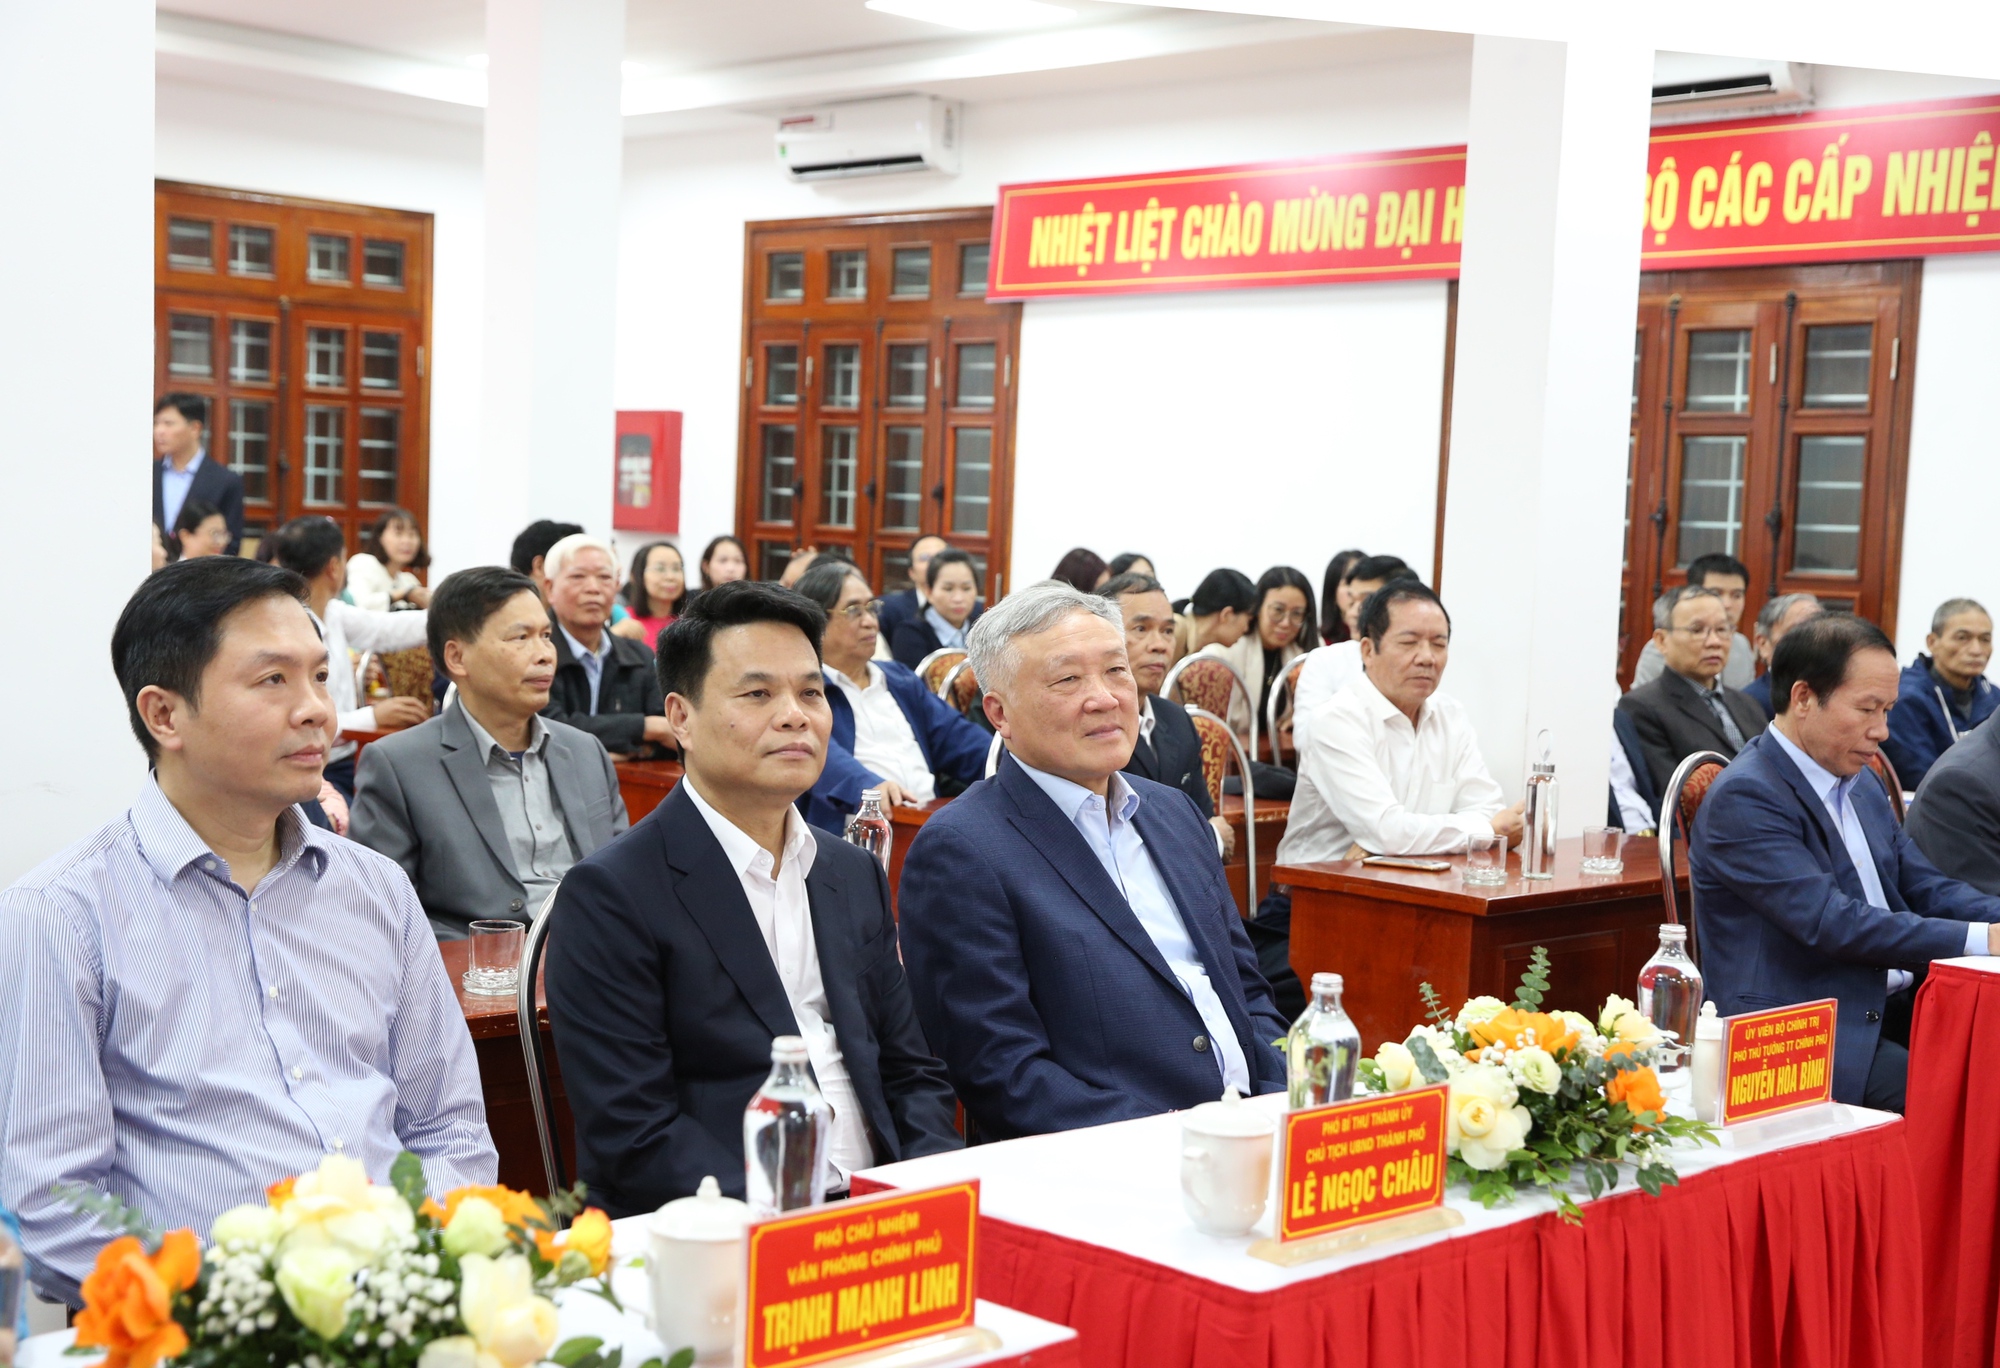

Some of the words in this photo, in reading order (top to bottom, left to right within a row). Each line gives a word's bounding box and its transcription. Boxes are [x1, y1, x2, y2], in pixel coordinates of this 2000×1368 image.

[1028, 202, 1112, 277] NHIỆT
[1114, 198, 1178, 273] LIỆT
[1181, 192, 1264, 260] CHÀO
[1269, 187, 1369, 254] MỪNG
[1375, 189, 1436, 259] ĐẠI
[1688, 150, 1774, 230] CÁC
[1782, 133, 1873, 224] CẤP
[1733, 1047, 1747, 1063] PHÓ
[1749, 1042, 1761, 1059] THỦ
[1786, 1040, 1795, 1052] TT
[1795, 1034, 1814, 1050] CHÍNH
[1815, 1029, 1828, 1046] PHỦ
[1745, 1024, 1756, 1040] ỦY
[1758, 1022, 1774, 1038] VIÊN
[1775, 1020, 1785, 1036] BỘ
[1786, 1016, 1807, 1032] CHÍNH
[1809, 1015, 1820, 1029] TRỊ
[1731, 1059, 1775, 1106] NGUYỄN
[1776, 1059, 1797, 1096] HÒA
[1799, 1055, 1826, 1091] BÌNH
[1306, 1141, 1326, 1164] CHỦ
[1327, 1142, 1348, 1162] TỊCH
[1349, 1137, 1374, 1155] UBND
[1376, 1129, 1406, 1149] THÀNH
[1407, 1121, 1426, 1143] PHỐ
[1322, 1115, 1340, 1136] PHÓ
[1341, 1113, 1352, 1133] BÍ
[1352, 1112, 1370, 1130] THƯ
[1371, 1107, 1400, 1126] THÀNH
[1400, 1102, 1413, 1121] ỦY
[1291, 1171, 1317, 1219] LÊ
[1321, 1166, 1377, 1214] NGỌC
[1382, 1149, 1435, 1199] CHÂU
[813, 1223, 844, 1251] PHÓ
[846, 1214, 875, 1244] CHỦ
[877, 1210, 920, 1237] NHIỆM
[821, 1251, 869, 1279] PHÒNG
[871, 1241, 912, 1267] CHÍNH
[914, 1228, 942, 1257] PHỦ
[762, 1291, 833, 1356] TRỊNH
[836, 1275, 905, 1338] MẠNH
[908, 1262, 960, 1316] LINH
